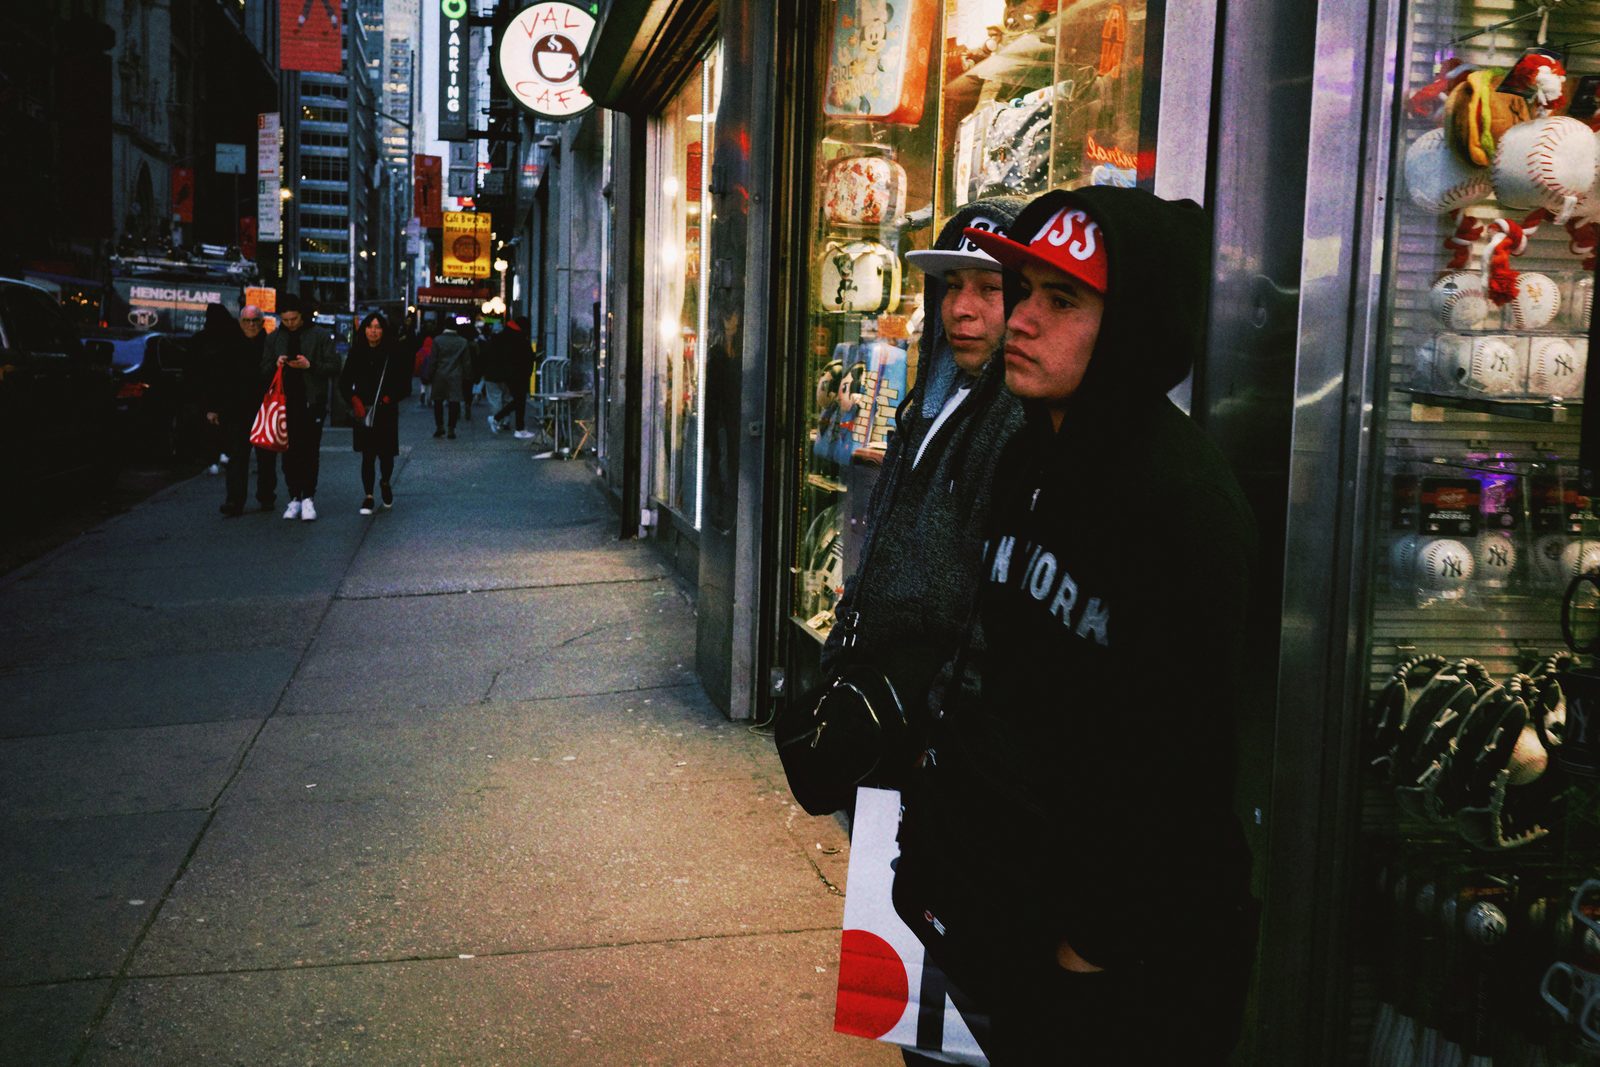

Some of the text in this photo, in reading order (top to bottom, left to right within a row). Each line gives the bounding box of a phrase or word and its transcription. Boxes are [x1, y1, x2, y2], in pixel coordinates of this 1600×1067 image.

[520, 7, 580, 39] VAL
[448, 19, 460, 112] PARKING
[515, 81, 589, 110] CAF
[431, 296, 472, 305] RESTAURANT
